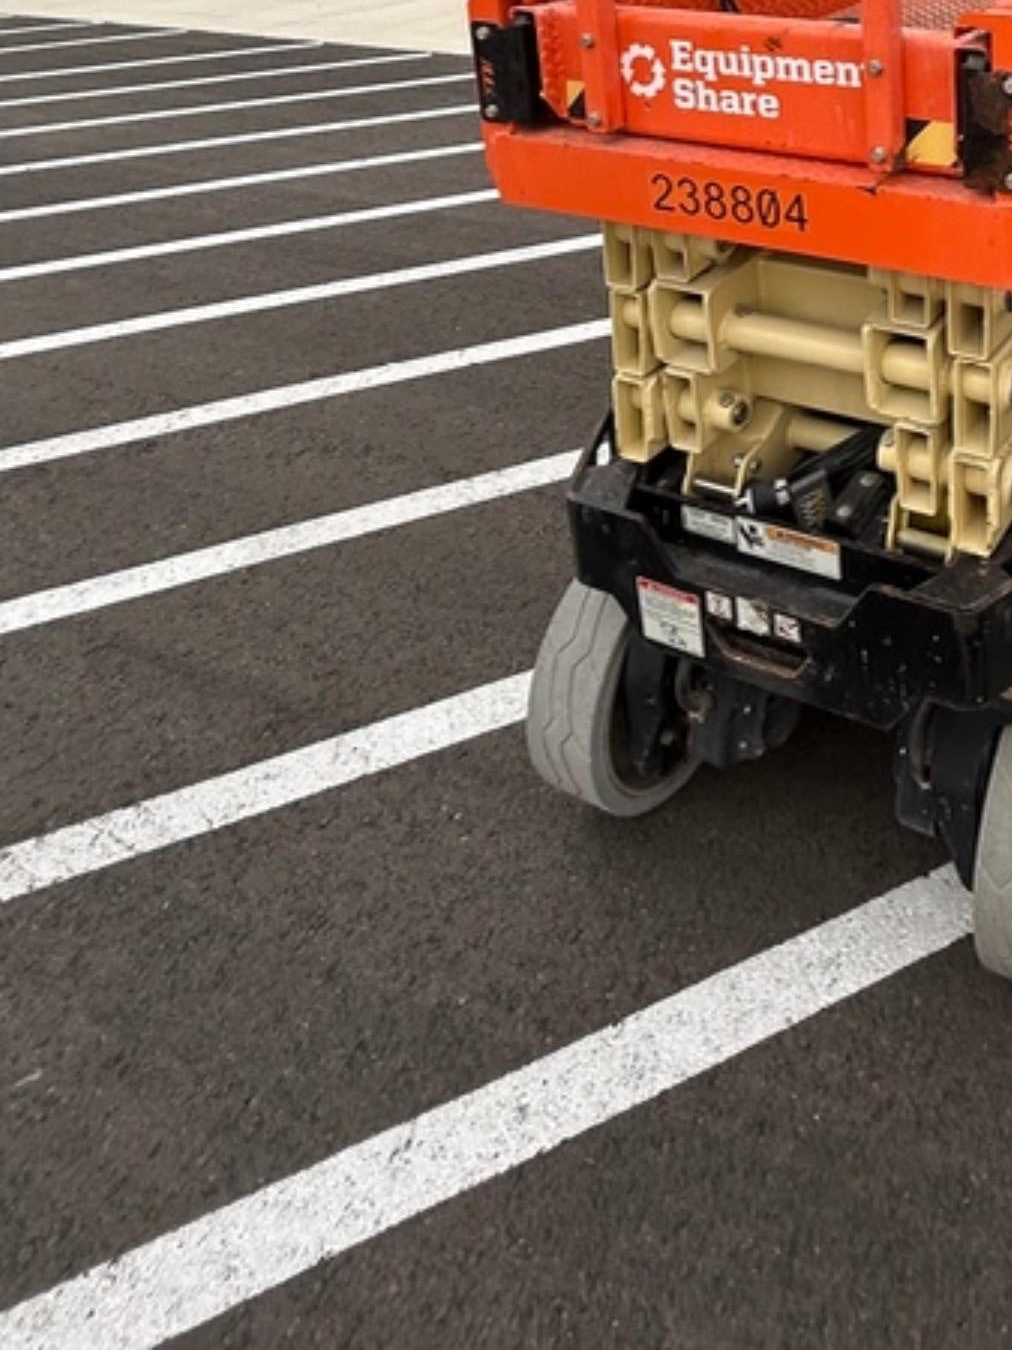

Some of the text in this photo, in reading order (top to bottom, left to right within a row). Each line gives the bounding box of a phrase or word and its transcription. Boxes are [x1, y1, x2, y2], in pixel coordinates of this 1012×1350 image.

[668, 37, 867, 89] Equipmen
[671, 77, 782, 120] Share
[650, 172, 809, 233] 238804
